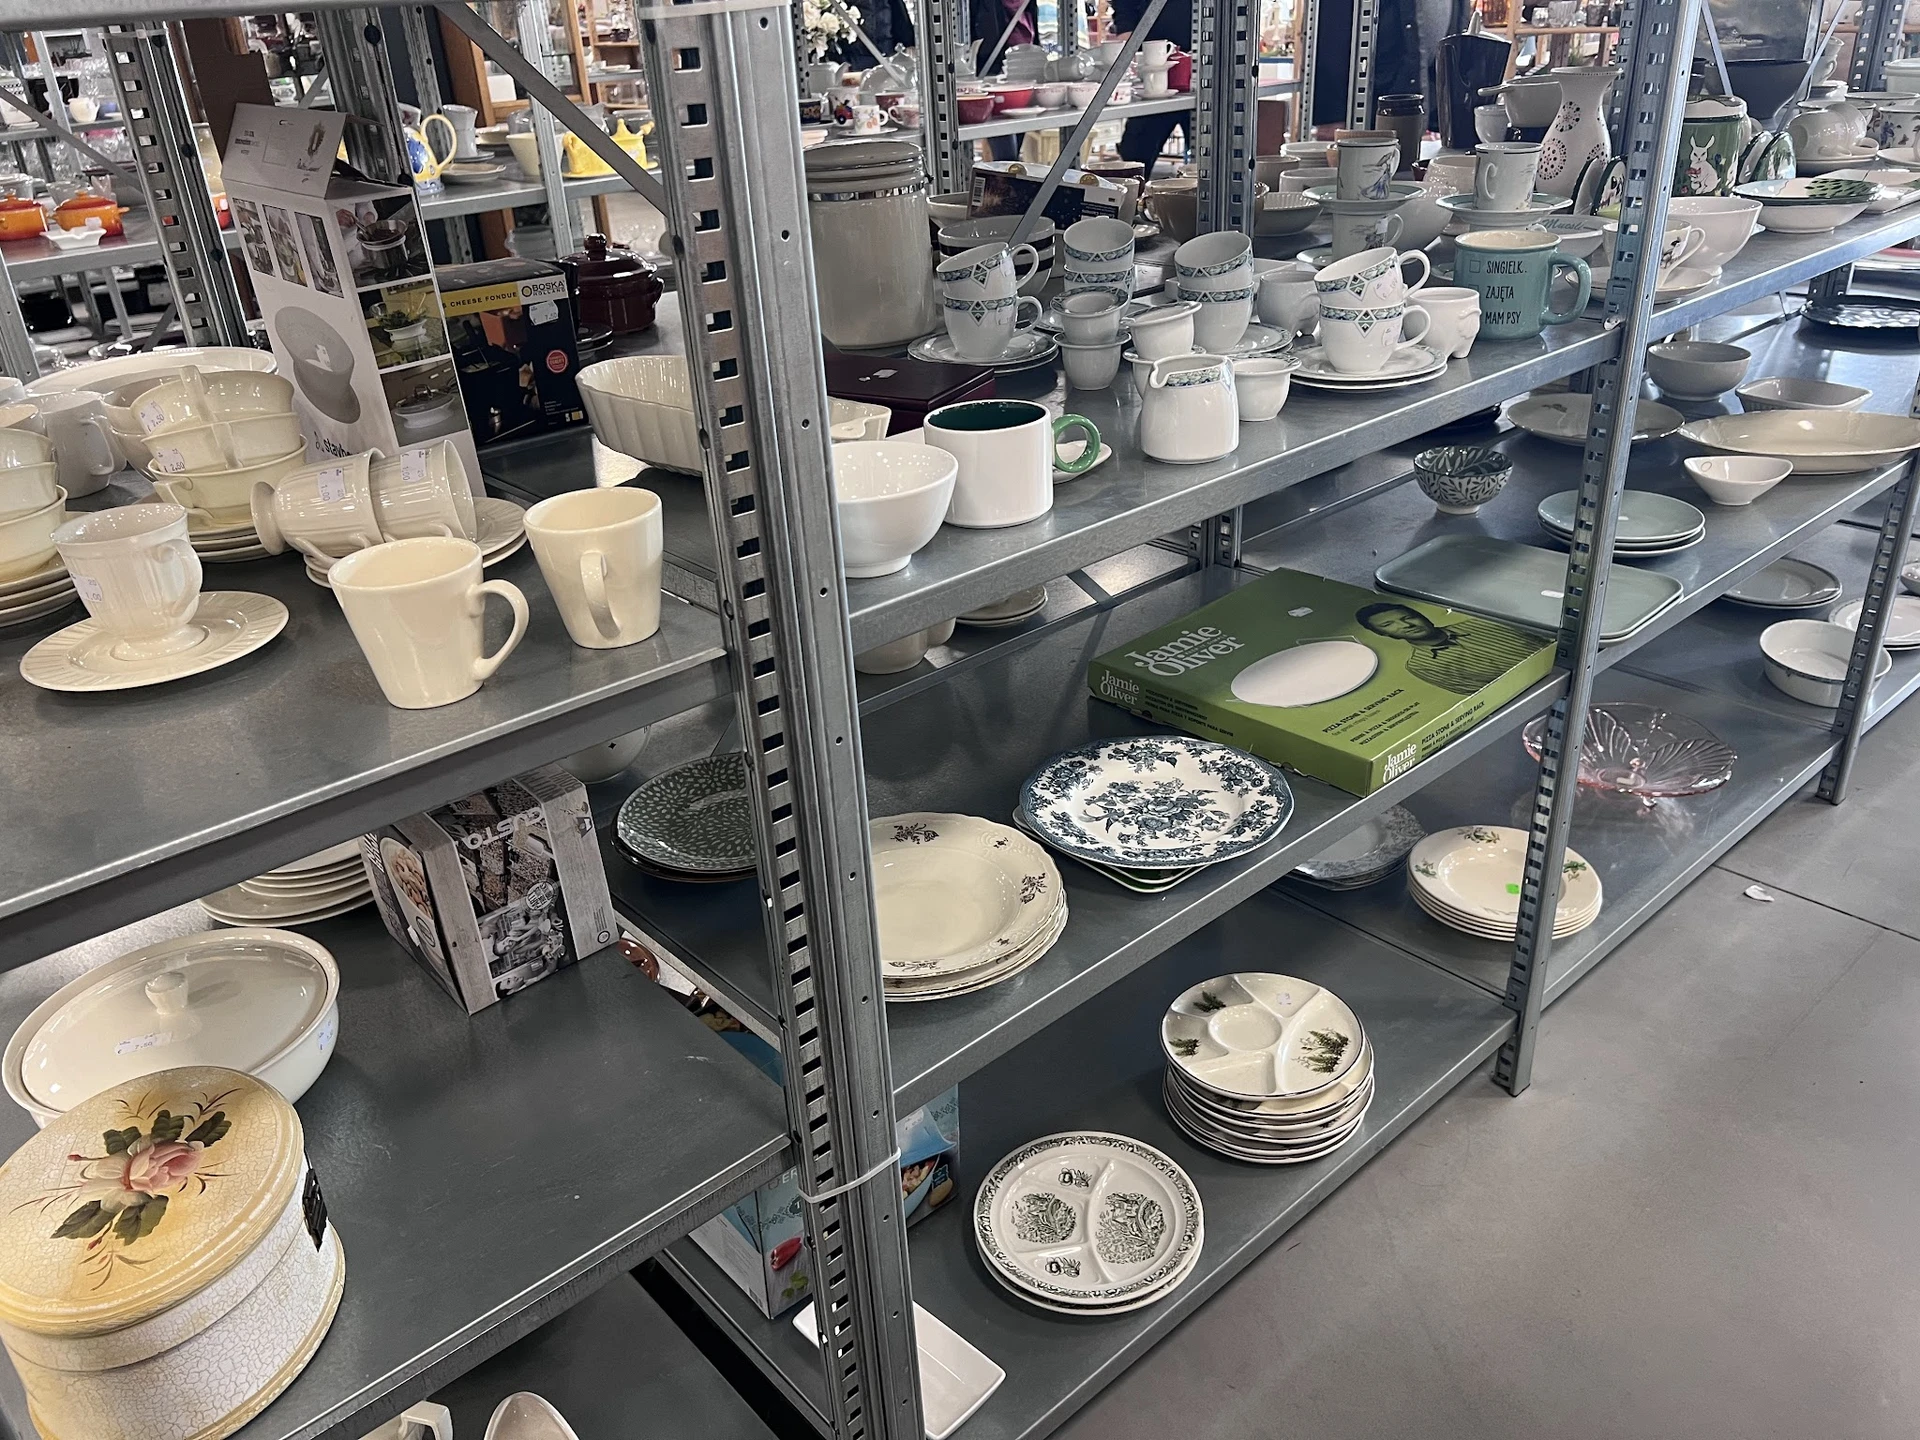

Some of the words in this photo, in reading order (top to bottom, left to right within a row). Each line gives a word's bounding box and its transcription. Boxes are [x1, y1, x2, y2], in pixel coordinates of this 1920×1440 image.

[532, 281, 564, 291] BOSKA
[533, 287, 565, 296] HOLLAND
[1485, 286, 1514, 302] ZAJĘTA
[450, 297, 482, 308] CHEESE
[485, 291, 517, 302] FONDUE
[1484, 312, 1504, 325] MAM
[1506, 311, 1522, 325] PSY
[170, 461, 185, 472] 2.50
[320, 485, 331, 501] 1.00
[1124, 627, 1222, 667] Jamie
[1148, 636, 1245, 676] Oliver
[1101, 670, 1139, 693] Jamie
[1100, 681, 1138, 705] Oliver
[1322, 723, 1341, 733] PIZZA
[1421, 733, 1435, 744] PIZZA
[1436, 724, 1450, 737] STONE
[1454, 709, 1473, 724] SERVING
[1473, 700, 1485, 713] RACK
[1384, 743, 1417, 770] Jamie
[1383, 757, 1416, 783] Oliver
[462, 806, 544, 850] GUSTA
